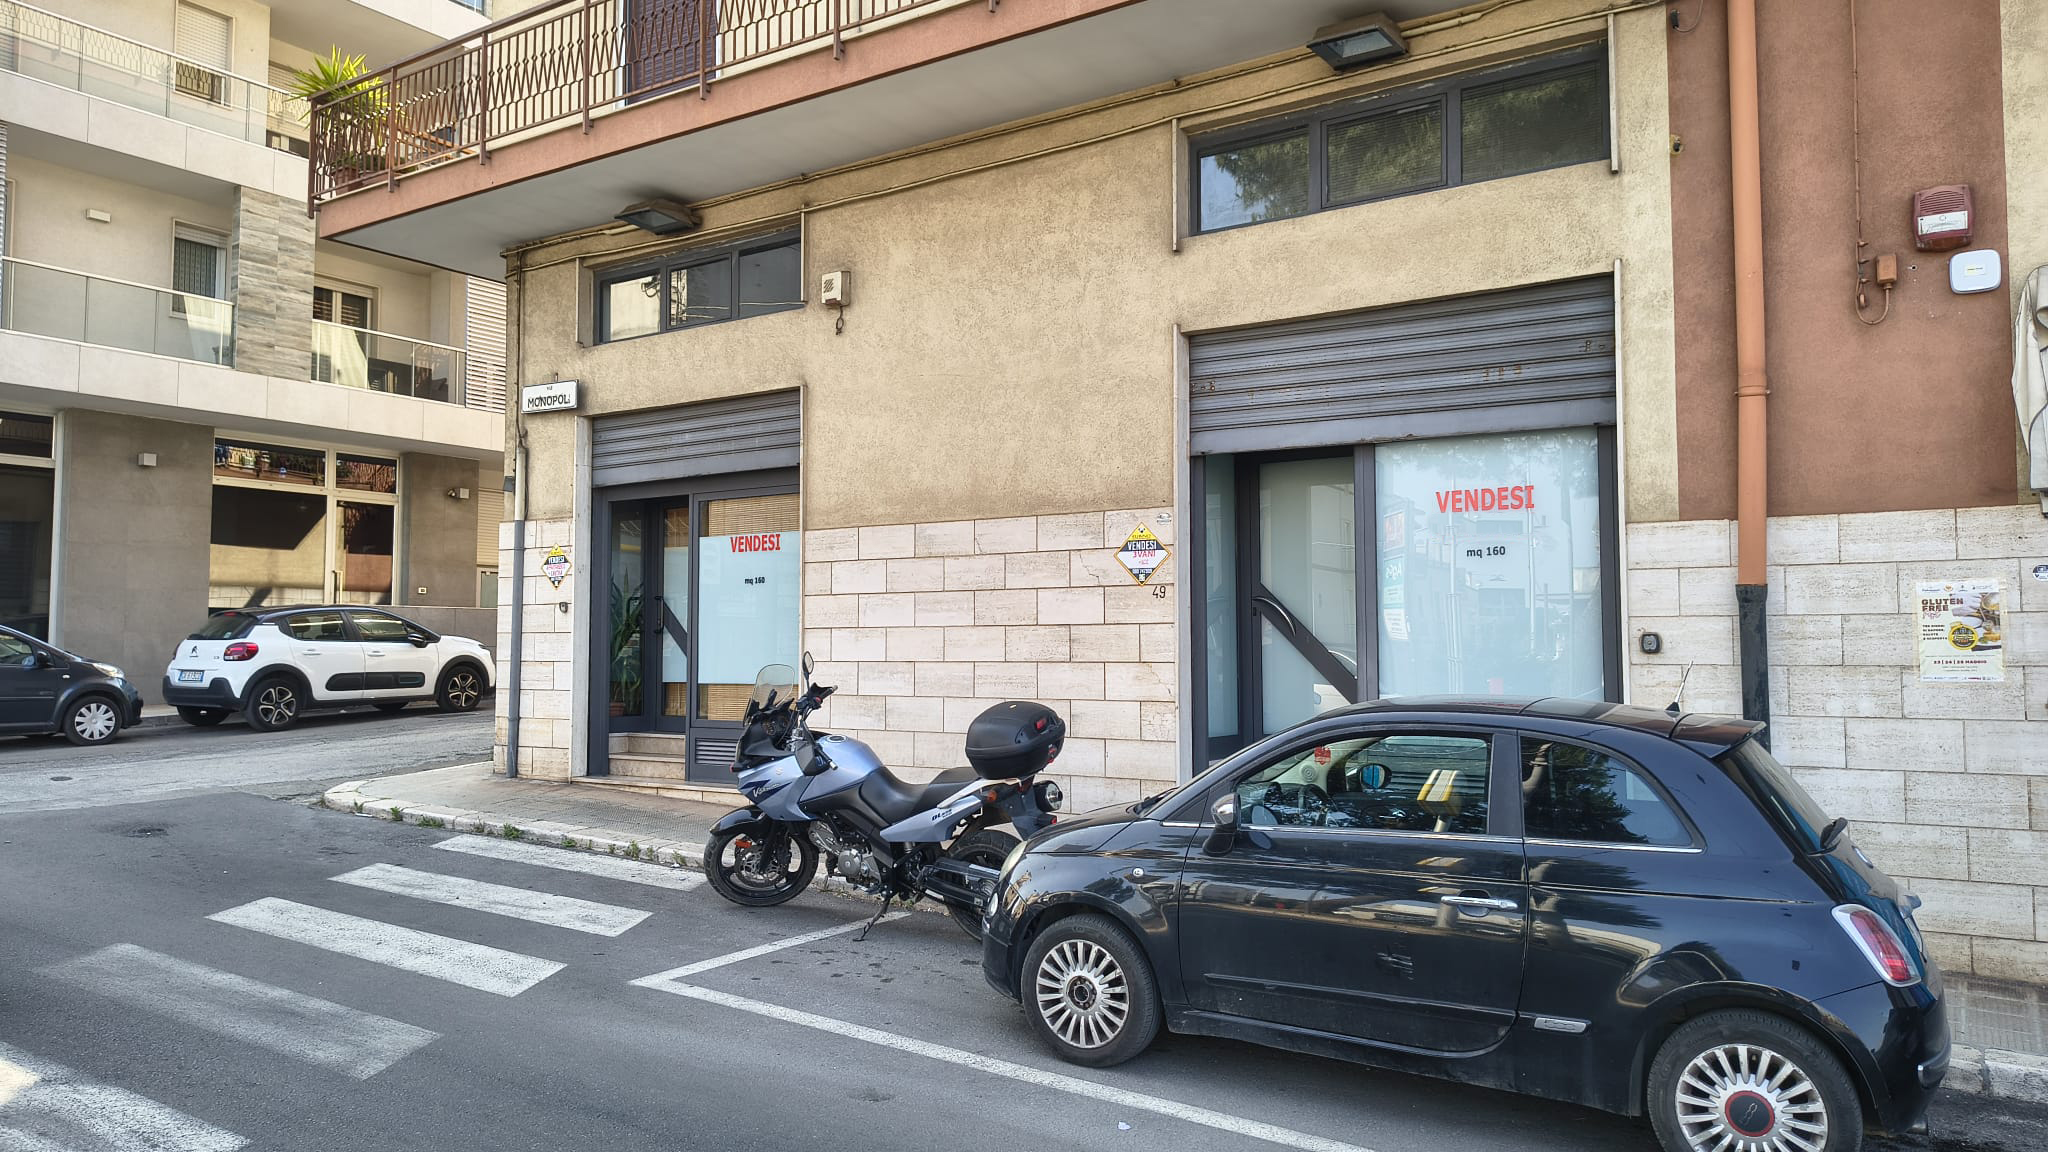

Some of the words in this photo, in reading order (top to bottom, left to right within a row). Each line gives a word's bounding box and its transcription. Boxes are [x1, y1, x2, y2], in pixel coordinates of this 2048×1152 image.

[1435, 485, 1535, 513] VENDESI
[730, 533, 781, 552] VENDESI
[1127, 540, 1157, 550] VENDESI
[1466, 548, 1483, 558] mq
[1486, 546, 1506, 556] 160
[754, 576, 766, 584] 160
[1152, 585, 1167, 599] 49
